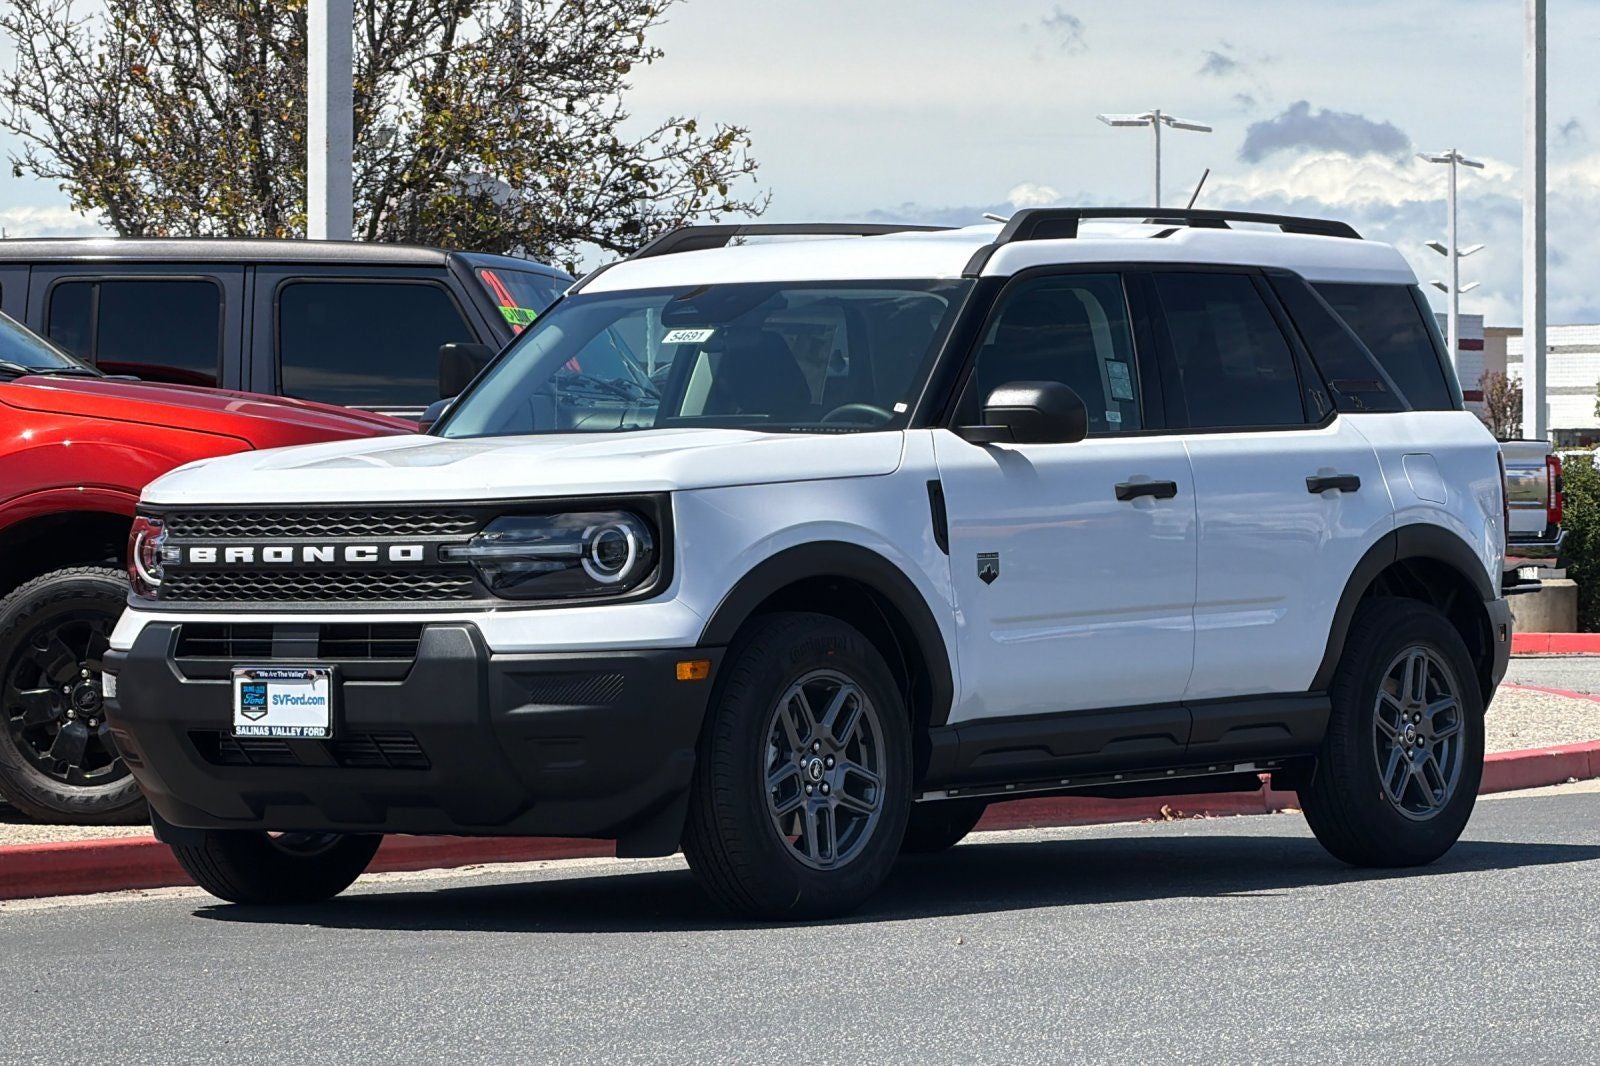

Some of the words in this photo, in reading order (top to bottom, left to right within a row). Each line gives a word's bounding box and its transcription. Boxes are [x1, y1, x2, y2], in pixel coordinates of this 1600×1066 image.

[669, 331, 706, 342] 54691
[189, 545, 424, 563] BRONCO
[243, 693, 265, 705] Ford
[272, 693, 325, 705] SVFord.com
[235, 726, 270, 736] SALINAS
[271, 726, 302, 736] VALLEY
[303, 727, 326, 737] FORD
